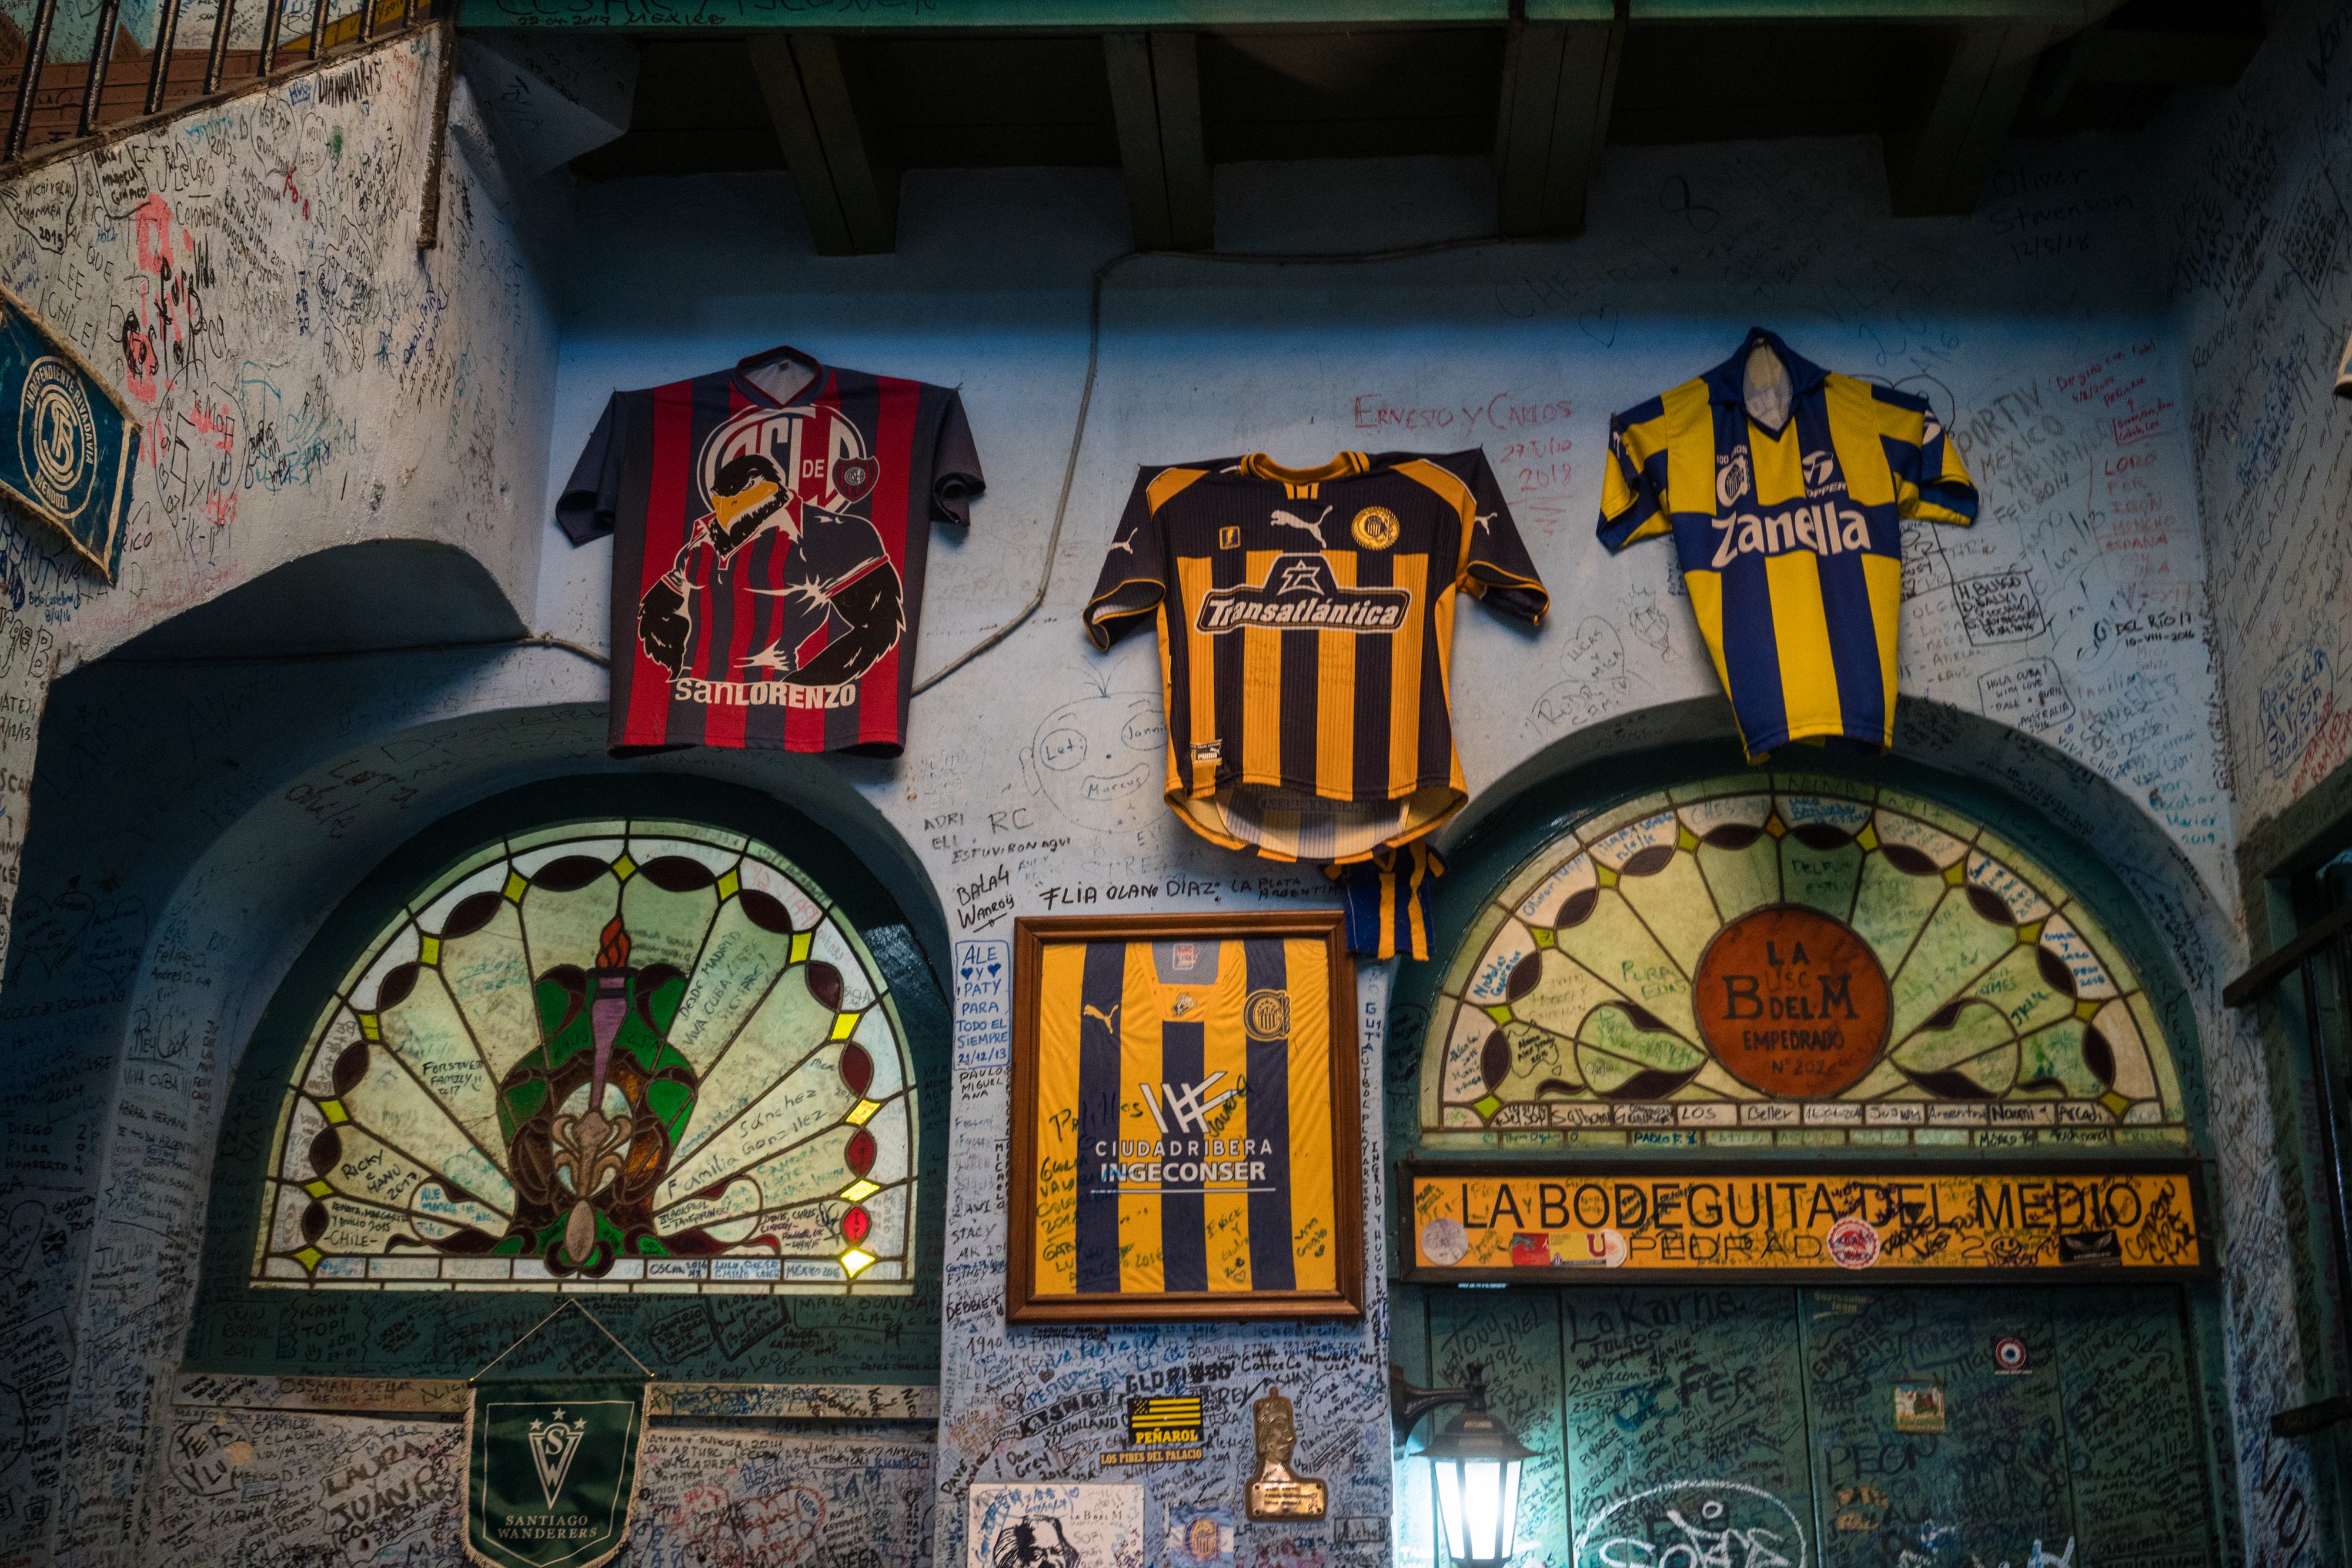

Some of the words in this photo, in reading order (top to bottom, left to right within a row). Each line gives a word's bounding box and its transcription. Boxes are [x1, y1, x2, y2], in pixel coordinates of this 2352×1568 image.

[26, 364, 76, 408] INDEPENDIENTE
[74, 386, 95, 464] RIVADAVIA
[803, 459, 824, 478] DE
[34, 471, 69, 510] MENDOZA
[1711, 500, 1872, 569] Zanella
[1208, 597, 1399, 627] Transatlántica
[962, 944, 998, 966] ALE
[1766, 941, 1810, 967] LA
[975, 968, 984, 981] Y
[964, 978, 1002, 998] PATY
[1721, 975, 1763, 1020] B
[1769, 995, 1815, 1021] DEL
[1817, 971, 1859, 1020] M
[962, 1001, 999, 1016] PARA
[956, 1019, 987, 1032] TODO
[991, 1018, 1007, 1029] EL
[1743, 1029, 1845, 1052] EMPEDRADO
[958, 1047, 1007, 1064] 21/12/13
[962, 1076, 1003, 1094] MIGUEL
[962, 1091, 989, 1101] ANA
[341, 1149, 383, 1180] RICKY
[1101, 1161, 1266, 1183] INGECONSER
[1462, 1182, 1524, 1229] LA
[1539, 1182, 1839, 1231] BODEGUITA
[1855, 1182, 1951, 1230] DEL
[1975, 1182, 2141, 1229] MEDIO
[1586, 1232, 1606, 1258] U
[1135, 1427, 1198, 1445] PEÑAROL
[1101, 1453, 1117, 1465] LOS
[1119, 1452, 1145, 1464] PIBES
[1147, 1450, 1164, 1462] DEL
[1165, 1448, 1202, 1461] PALACIO
[505, 1514, 588, 1526] SANTIAGO
[497, 1527, 598, 1540] WANDERERS
